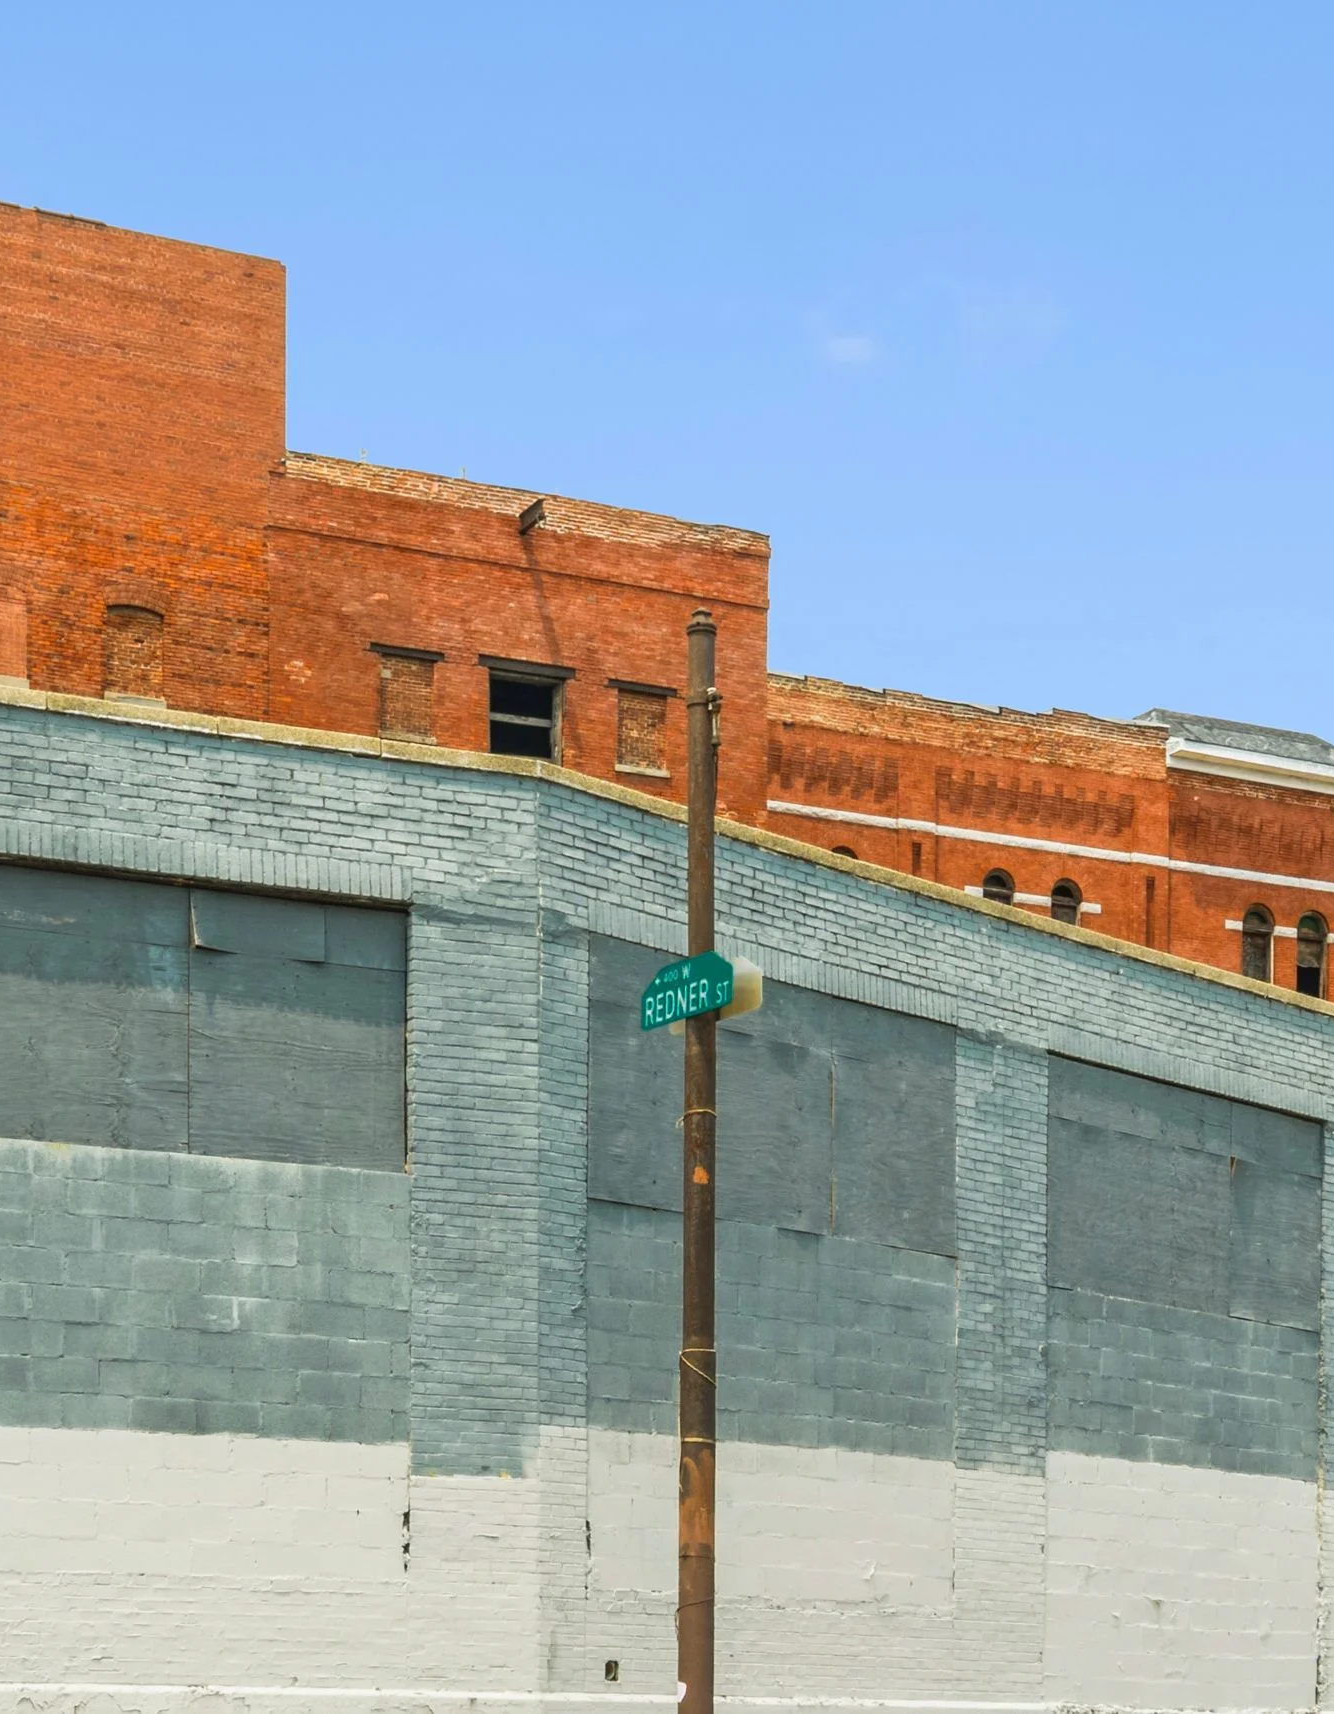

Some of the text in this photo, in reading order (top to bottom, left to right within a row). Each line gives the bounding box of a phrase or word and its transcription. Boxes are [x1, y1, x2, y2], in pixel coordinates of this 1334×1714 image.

[681, 962, 691, 979] W
[645, 978, 729, 1026] REDNER ST
